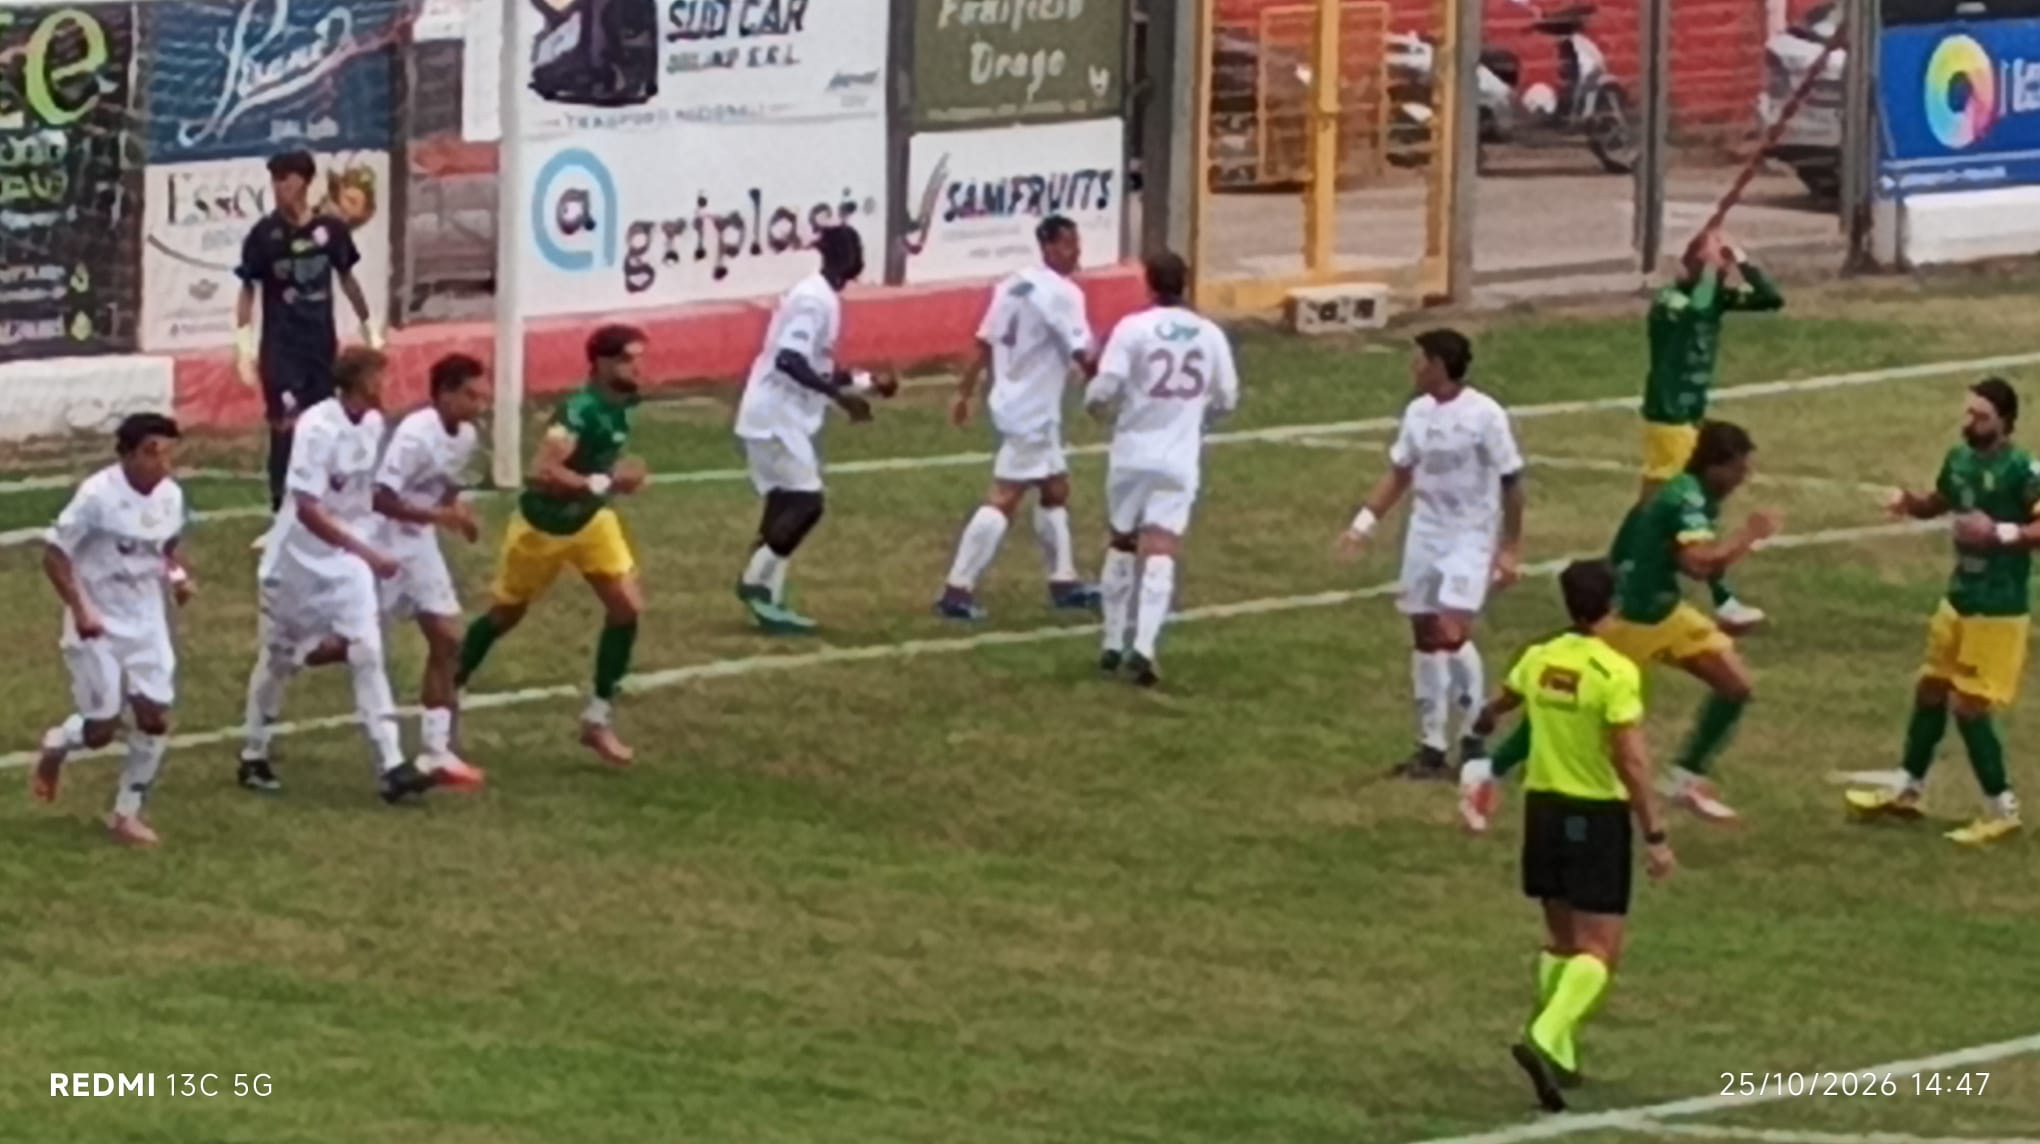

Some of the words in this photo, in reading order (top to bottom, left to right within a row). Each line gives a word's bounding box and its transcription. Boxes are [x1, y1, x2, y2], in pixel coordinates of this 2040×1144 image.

[738, 0, 808, 36] CAR
[969, 40, 1066, 101] Drago
[943, 168, 1113, 222] SAMFRUITS
[1147, 347, 1204, 401] 25
